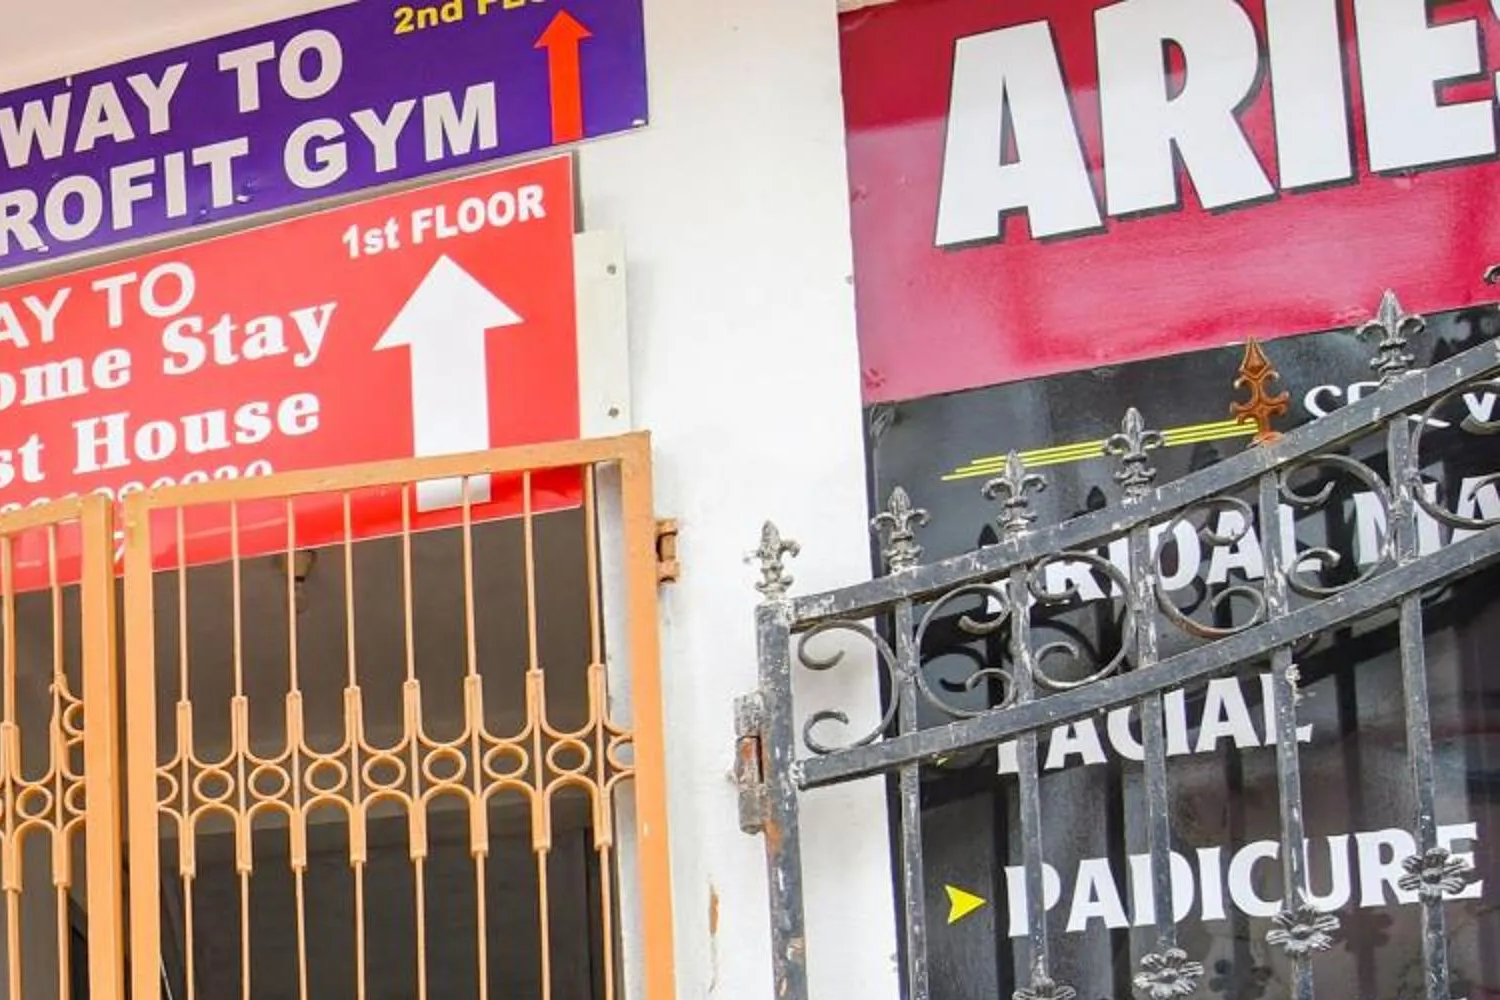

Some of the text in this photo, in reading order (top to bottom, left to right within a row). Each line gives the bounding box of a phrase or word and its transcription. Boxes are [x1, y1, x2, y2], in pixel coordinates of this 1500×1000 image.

[218, 28, 344, 114] TO
[284, 81, 499, 189] GYM
[933, 0, 1500, 250] ARIE
[342, 183, 548, 259] 1st FLOOR
[92, 261, 197, 329] TO
[161, 301, 338, 377] Stay
[72, 390, 320, 476] House
[997, 673, 1313, 775] ACIAL
[1004, 822, 1485, 937] PADICURE
